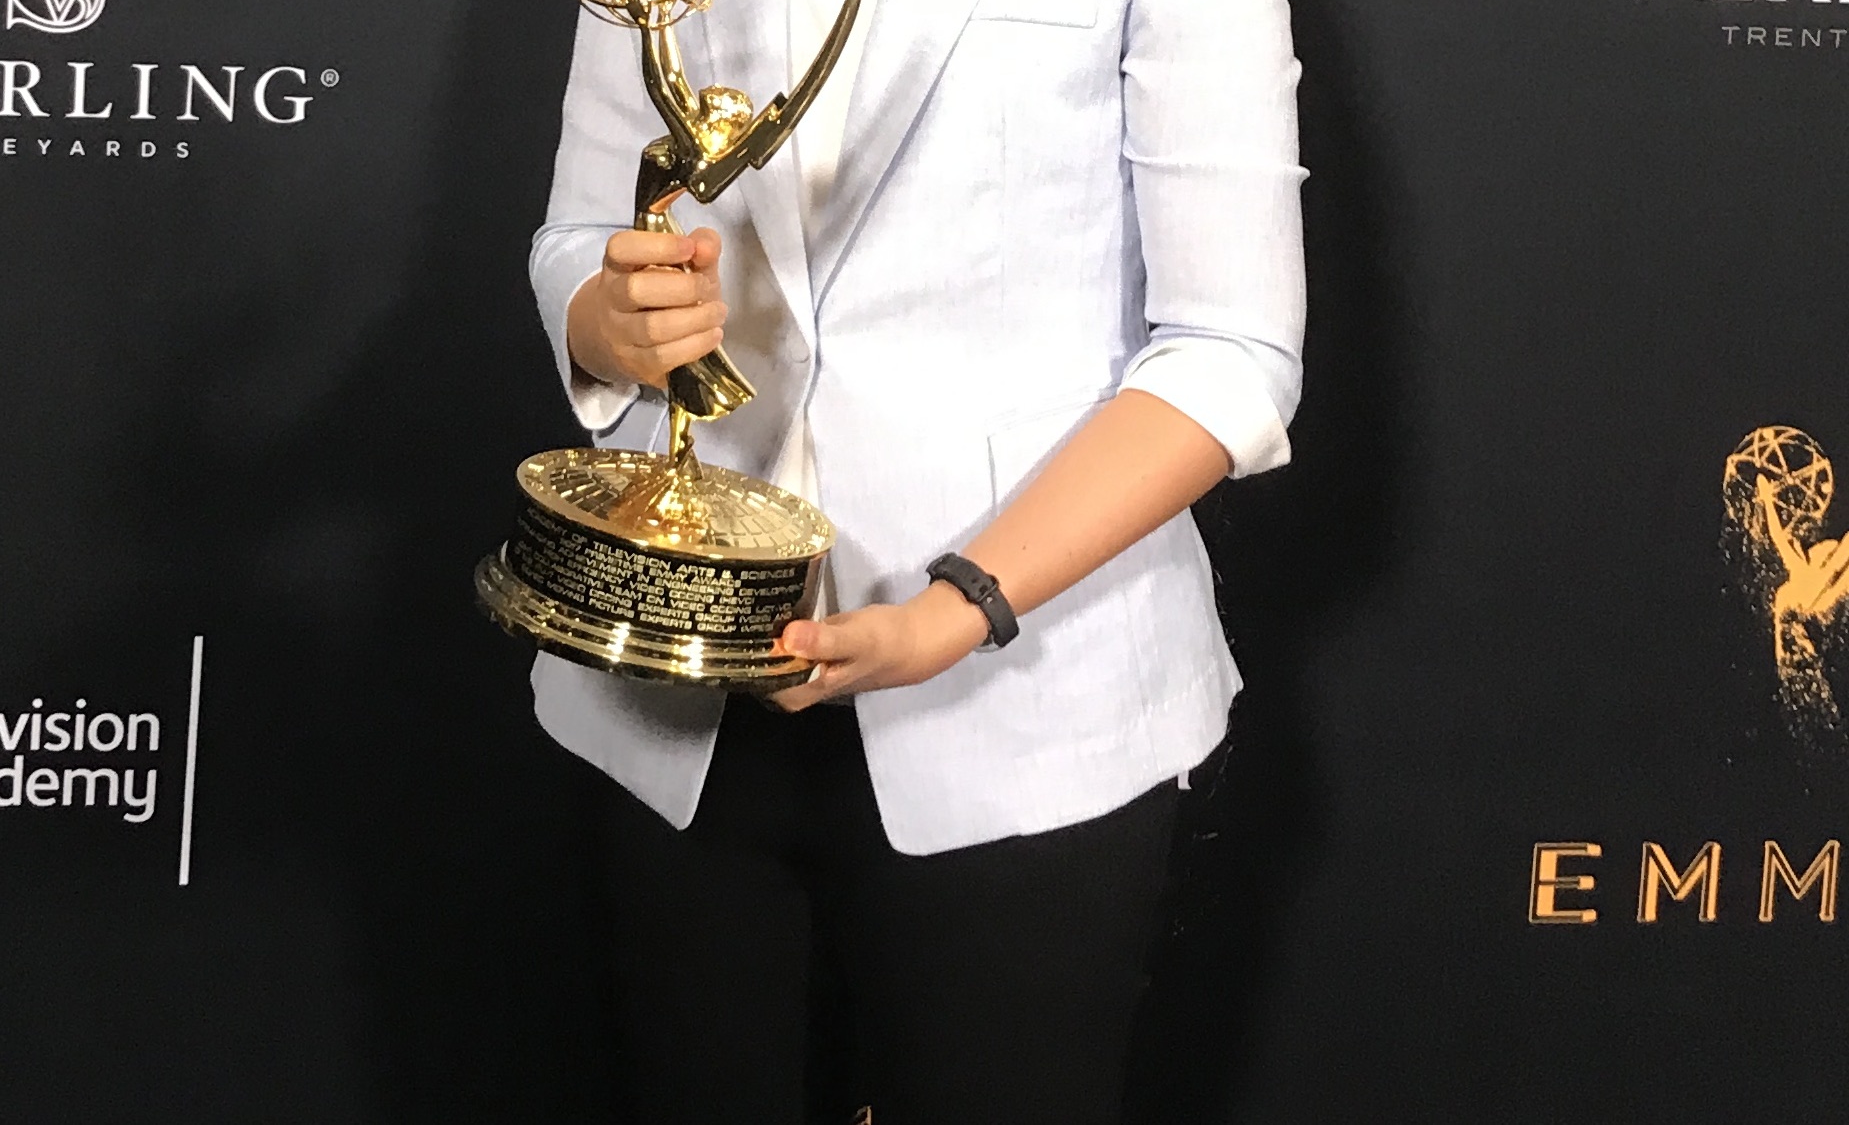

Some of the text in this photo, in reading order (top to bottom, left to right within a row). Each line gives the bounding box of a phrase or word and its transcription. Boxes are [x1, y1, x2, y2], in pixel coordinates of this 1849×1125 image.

[1721, 25, 1848, 49] TRENT
[2, 137, 190, 159] EYARDS
[584, 547, 644, 573] PRIMETIME
[649, 566, 688, 581] EMMY
[691, 575, 742, 588] AWARDS
[593, 541, 672, 570] TELEVISION
[676, 563, 716, 578] ARTS
[740, 567, 796, 581] SCIENCES
[609, 584, 643, 601] TEAM
[646, 594, 666, 606] ON
[669, 598, 706, 612] VIDEO
[709, 604, 752, 615] CODING
[629, 580, 665, 596] VIDEO
[668, 589, 715, 604] CODING
[637, 573, 650, 584] IN
[654, 577, 735, 596] ENGINEERING
[588, 597, 635, 619] PICTURE
[640, 612, 693, 630] EXPERTS
[697, 621, 737, 633] GROUP
[589, 587, 633, 608] CODING
[637, 602, 691, 620] EXPERTS
[695, 612, 736, 623] GROUP
[0, 697, 161, 751] vision
[0, 754, 157, 823] demy
[1528, 839, 1841, 924] EMM
